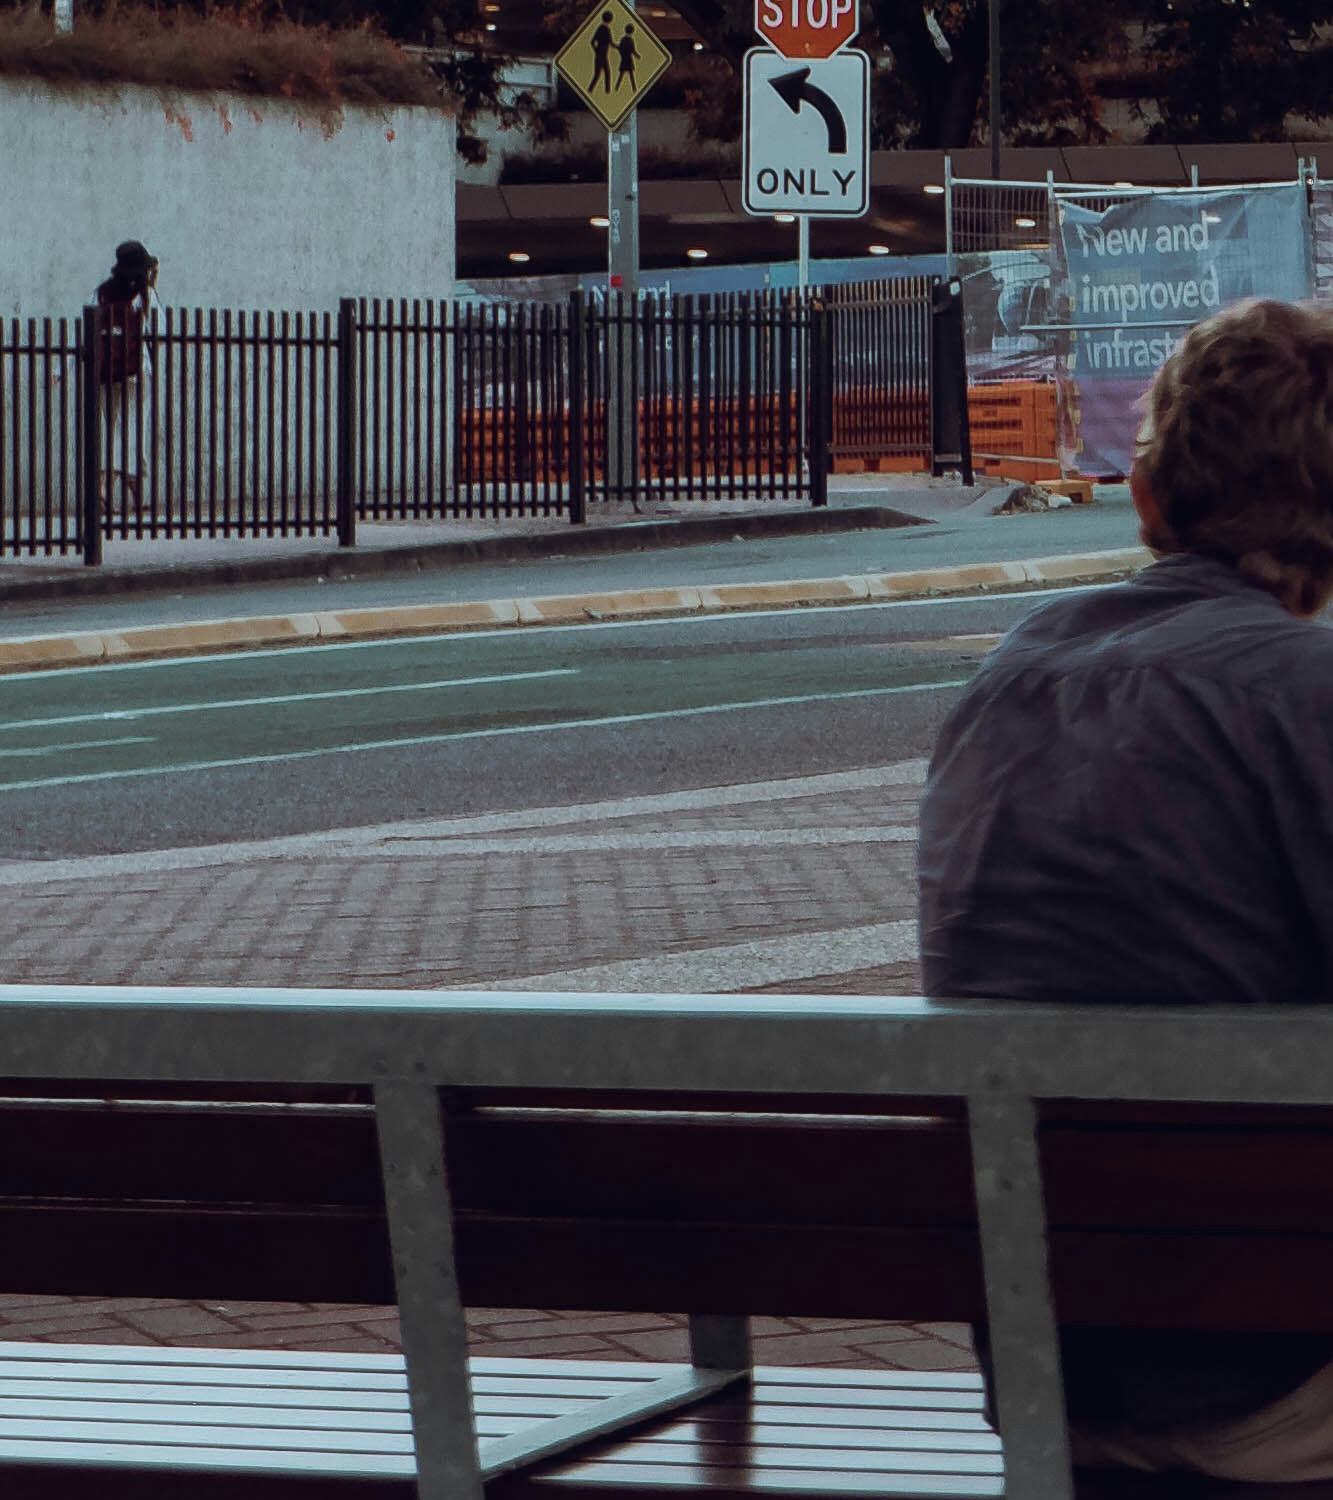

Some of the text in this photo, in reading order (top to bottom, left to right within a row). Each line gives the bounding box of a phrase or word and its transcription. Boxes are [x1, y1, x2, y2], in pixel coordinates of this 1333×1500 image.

[757, 168, 856, 196] ONLY
[1076, 210, 1208, 258] New and
[1081, 262, 1221, 323] improved
[1084, 328, 1177, 369] infrast
